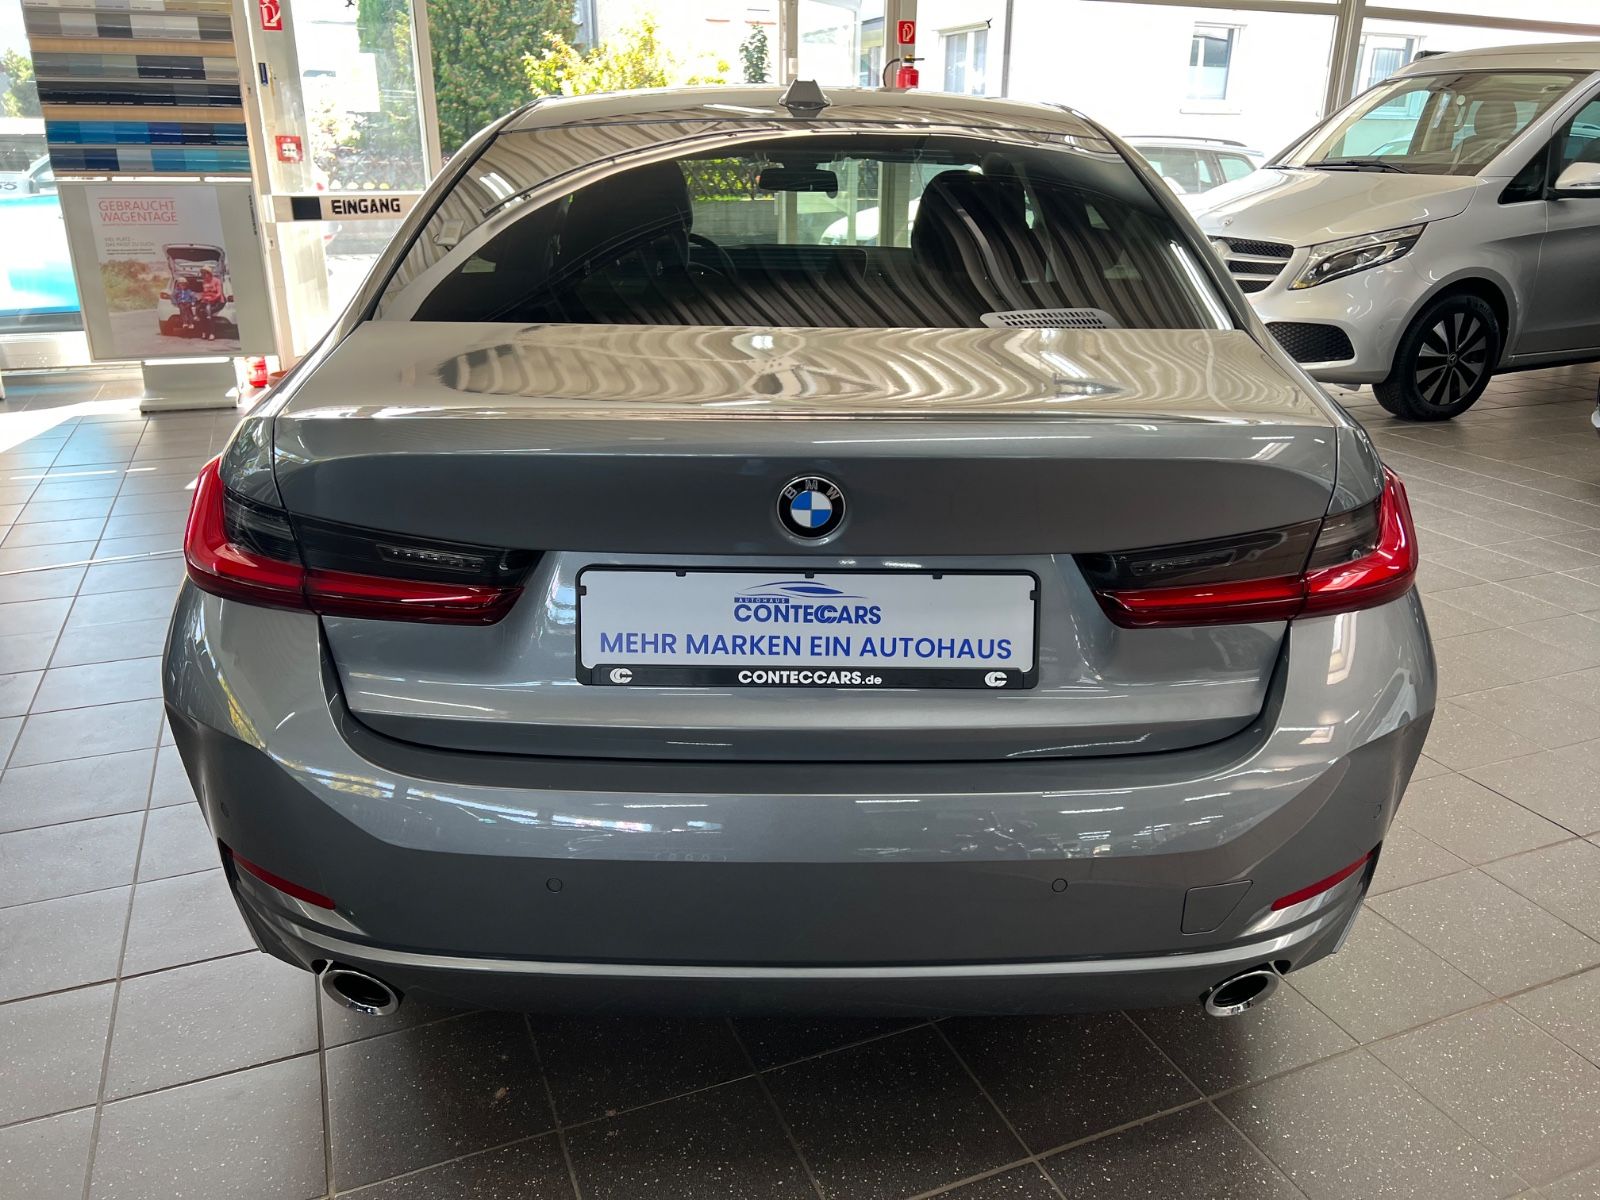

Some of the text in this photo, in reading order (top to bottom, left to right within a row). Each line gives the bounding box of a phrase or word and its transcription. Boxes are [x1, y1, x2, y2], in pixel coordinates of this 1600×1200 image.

[98, 200, 176, 211] GEBRAUCHT
[331, 198, 400, 214] EINGANG
[100, 211, 178, 222] WAGENTAGE
[784, 479, 840, 500] BMW
[734, 604, 881, 624] CONTECCARS
[600, 632, 1012, 659] MEHR MARKEN EIN AUTOHAUS
[738, 670, 882, 685] CONTECCARS.de
